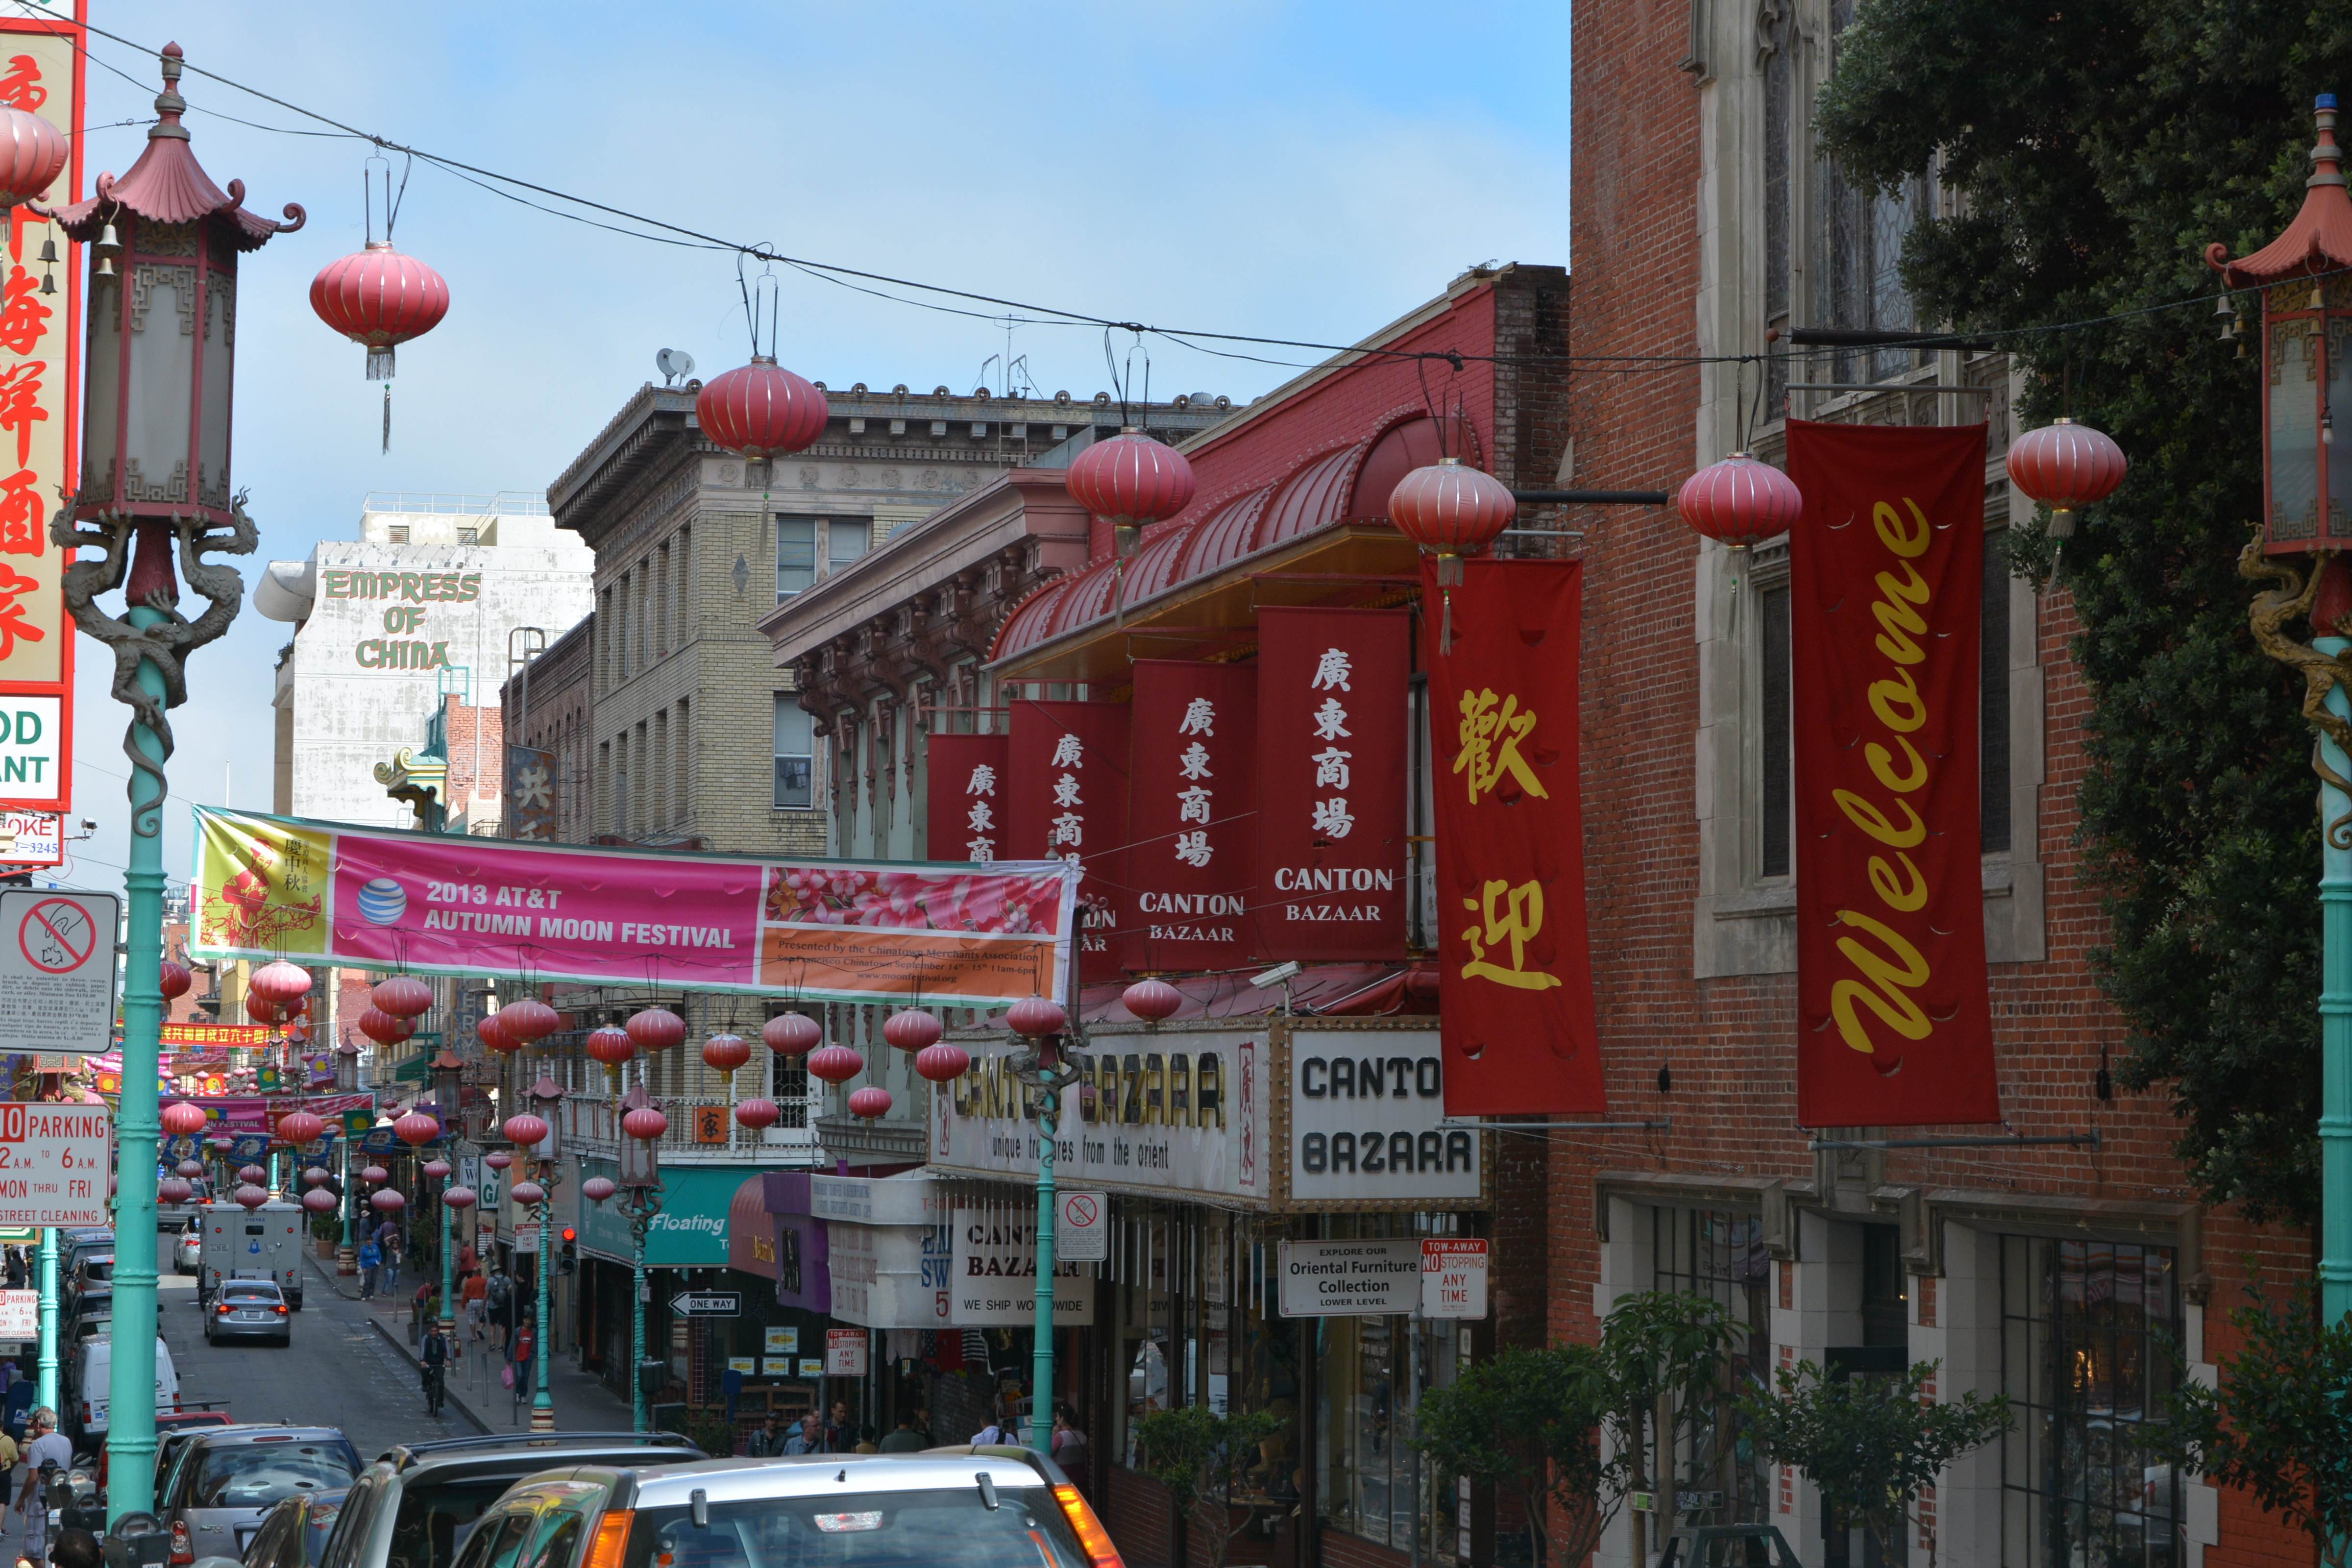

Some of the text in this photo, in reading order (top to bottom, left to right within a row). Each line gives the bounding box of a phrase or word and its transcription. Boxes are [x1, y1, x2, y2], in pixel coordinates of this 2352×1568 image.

[321, 570, 482, 604] EMPRESS
[384, 606, 426, 635] OF
[355, 638, 452, 672] CHINA
[1311, 648, 1354, 838] 廣東商場
[1175, 698, 1215, 867] 廣東商場
[1832, 497, 1932, 1054] Welcome
[1, 818, 52, 836] OKE
[1452, 687, 1562, 990] 歡迎
[284, 839, 301, 891] 慶中秋
[1274, 868, 1392, 891] CANTON
[426, 882, 562, 910] 2013 AT&T
[1139, 892, 1244, 916] CANTON
[1285, 906, 1381, 921] BAZAAR
[423, 909, 735, 949] AUTUMN MOON FESTIVAL
[1149, 925, 1234, 941] BAZAAR
[778, 940, 1039, 962] Presented by the Chinatown Merchants Association
[796, 956, 840, 965] Francisco
[844, 958, 892, 968] Chinatown
[895, 962, 945, 970] September
[992, 965, 1036, 976] 11am-6pm
[858, 971, 957, 983] www.moonfestival.org
[1079, 1052, 1226, 1129] BAZAAR
[29, 1116, 104, 1138] PARKING
[14, 1158, 34, 1169] A.M.
[62, 1147, 74, 1169] 6
[78, 1158, 98, 1169] A.M.
[993, 1135, 1021, 1164] unique
[1082, 1134, 1104, 1165] from
[1113, 1136, 1128, 1166] the
[1138, 1138, 1169, 1170] orient
[1302, 1131, 1471, 1173] BAZAAR
[33, 1184, 58, 1193] THRU
[69, 1180, 91, 1198] FRI
[0, 1210, 98, 1222] STREET CLEANING
[649, 1213, 725, 1236] Floating
[719, 1239, 729, 1250] T
[1428, 1242, 1480, 1251] TOW-AWAY
[967, 1256, 1080, 1277] BAZAR
[1290, 1260, 1417, 1274] Oriental Furniture
[1422, 1254, 1485, 1271] NO STOPPING
[1319, 1280, 1390, 1293] Collection
[1443, 1274, 1467, 1286] ANY
[7, 1295, 36, 1303] PARKING
[690, 1300, 732, 1308] ONE WAY
[964, 1300, 1082, 1311] WE SHIP WODWIDE
[1440, 1290, 1468, 1302] TIME
[20, 1307, 24, 1315] 6
[828, 1338, 865, 1348] NO STOPPING
